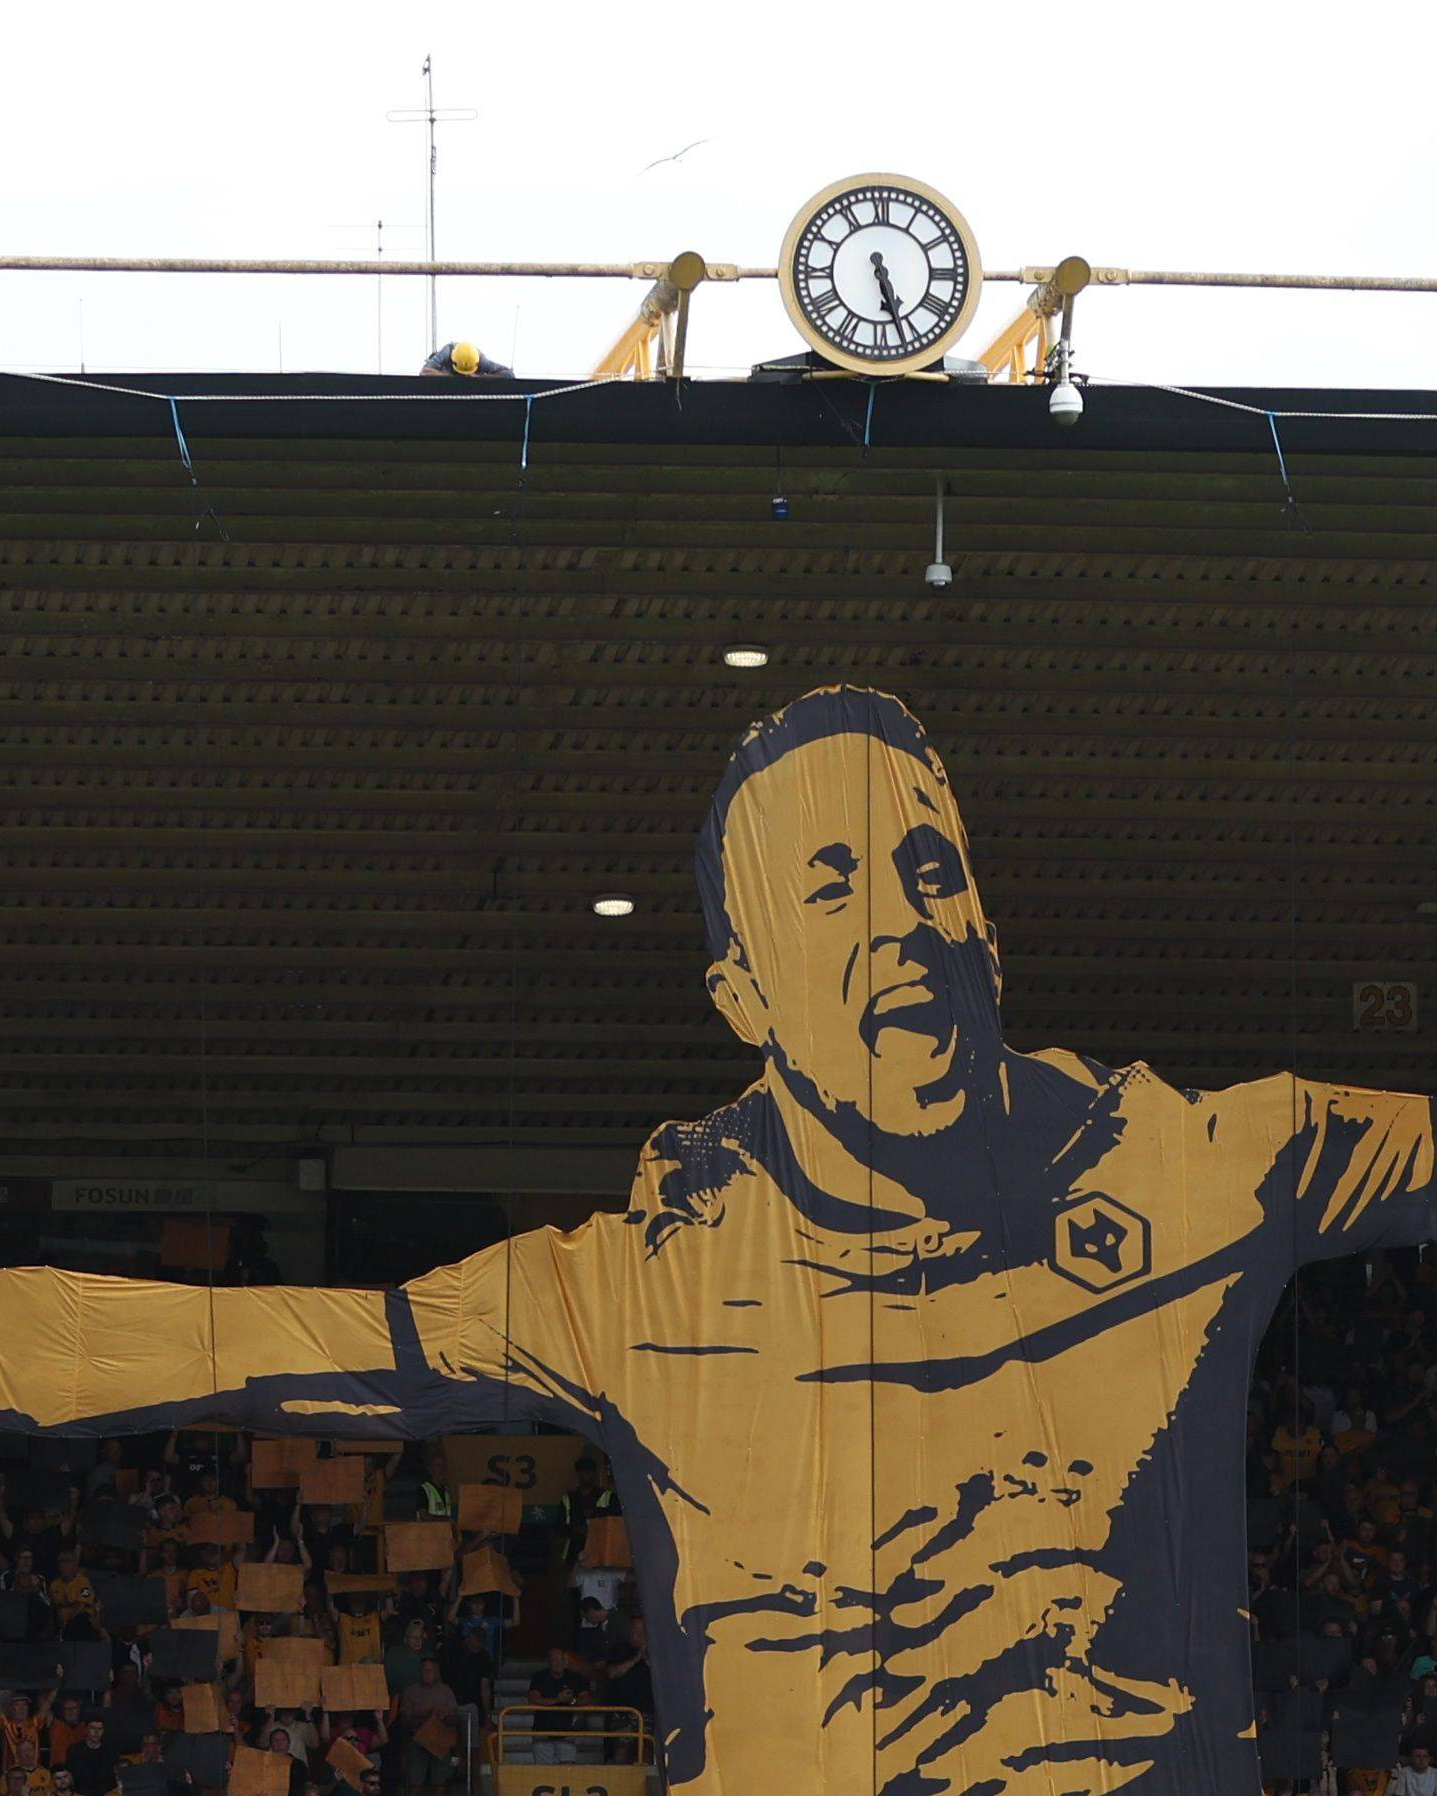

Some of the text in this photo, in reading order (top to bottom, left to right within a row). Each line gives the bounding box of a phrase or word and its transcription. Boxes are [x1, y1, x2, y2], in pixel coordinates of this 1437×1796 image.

[1360, 985, 1412, 1025] 23
[76, 1189, 150, 1205] FOSUN
[487, 1455, 537, 1489] S3
